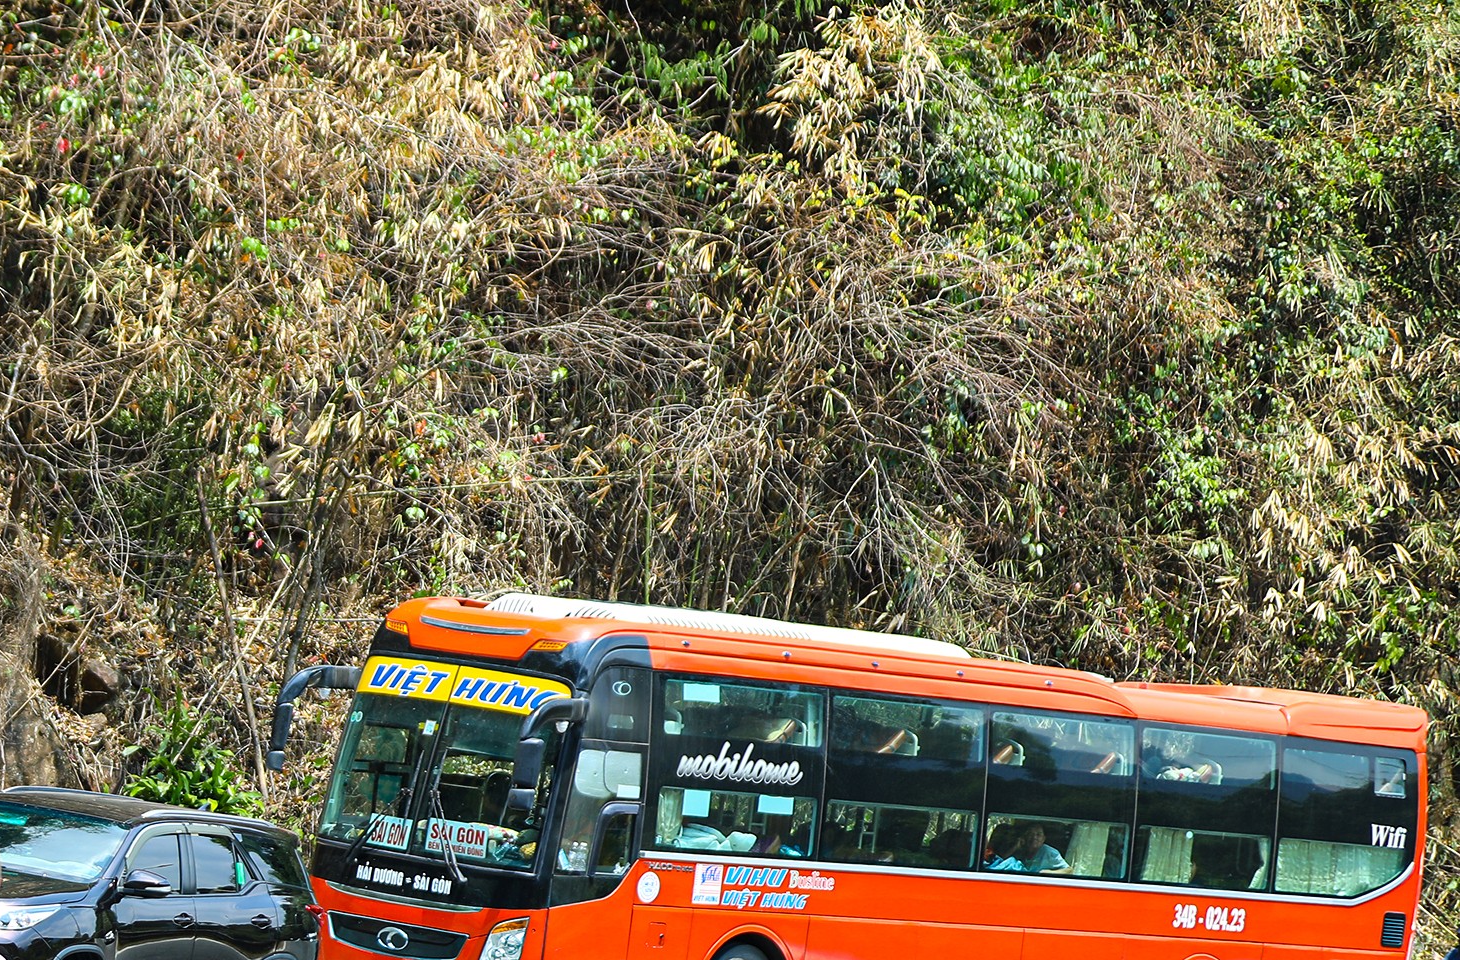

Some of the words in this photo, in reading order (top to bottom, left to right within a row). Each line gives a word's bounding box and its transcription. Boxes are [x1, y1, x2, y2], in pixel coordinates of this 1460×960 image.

[369, 664, 450, 696] VIỆT
[676, 741, 804, 786] mobihome
[456, 825, 486, 846] GÒN
[1371, 824, 1408, 849] Wifi
[356, 861, 372, 881] HẢI
[373, 868, 404, 887] DƯƠNG
[723, 866, 788, 887] VIHU
[789, 870, 835, 890] Busline
[721, 888, 760, 909] VIỆT
[760, 891, 810, 909] HƯNG
[1172, 904, 1197, 929] 34B
[1205, 905, 1246, 932] 024.23
